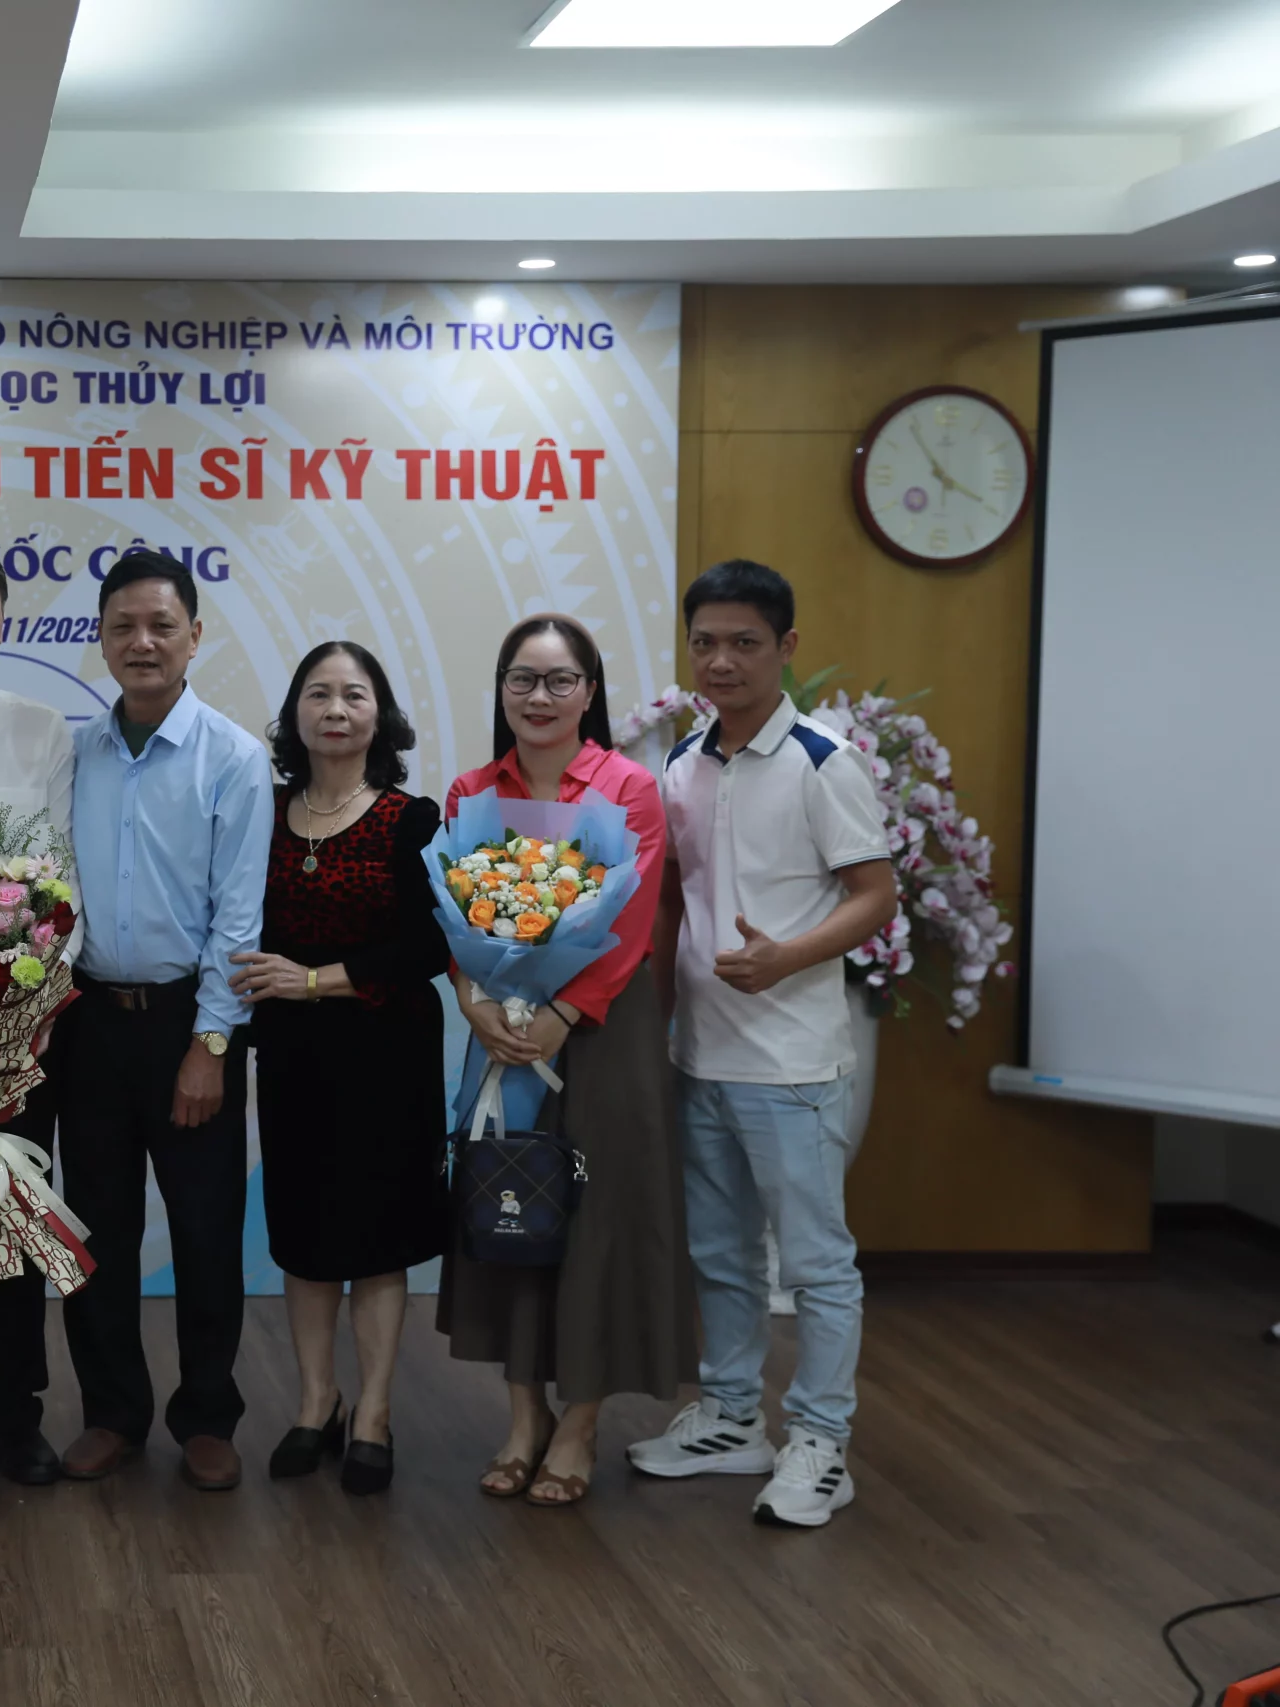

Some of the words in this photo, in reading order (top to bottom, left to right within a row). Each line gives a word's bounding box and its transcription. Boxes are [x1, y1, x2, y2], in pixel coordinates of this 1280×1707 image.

[19, 313, 131, 349] NÔNG
[144, 314, 288, 359] NGHIỆP
[301, 313, 352, 350] VÀ
[364, 313, 434, 350] MÔI
[447, 314, 615, 351] TRƯỜNG
[74, 361, 184, 406] THỦY
[200, 370, 266, 411] LỢI
[24, 429, 174, 499] TIẾN
[200, 436, 266, 500] SĨ
[290, 437, 374, 501] KỸ
[396, 437, 606, 513] THUẬT
